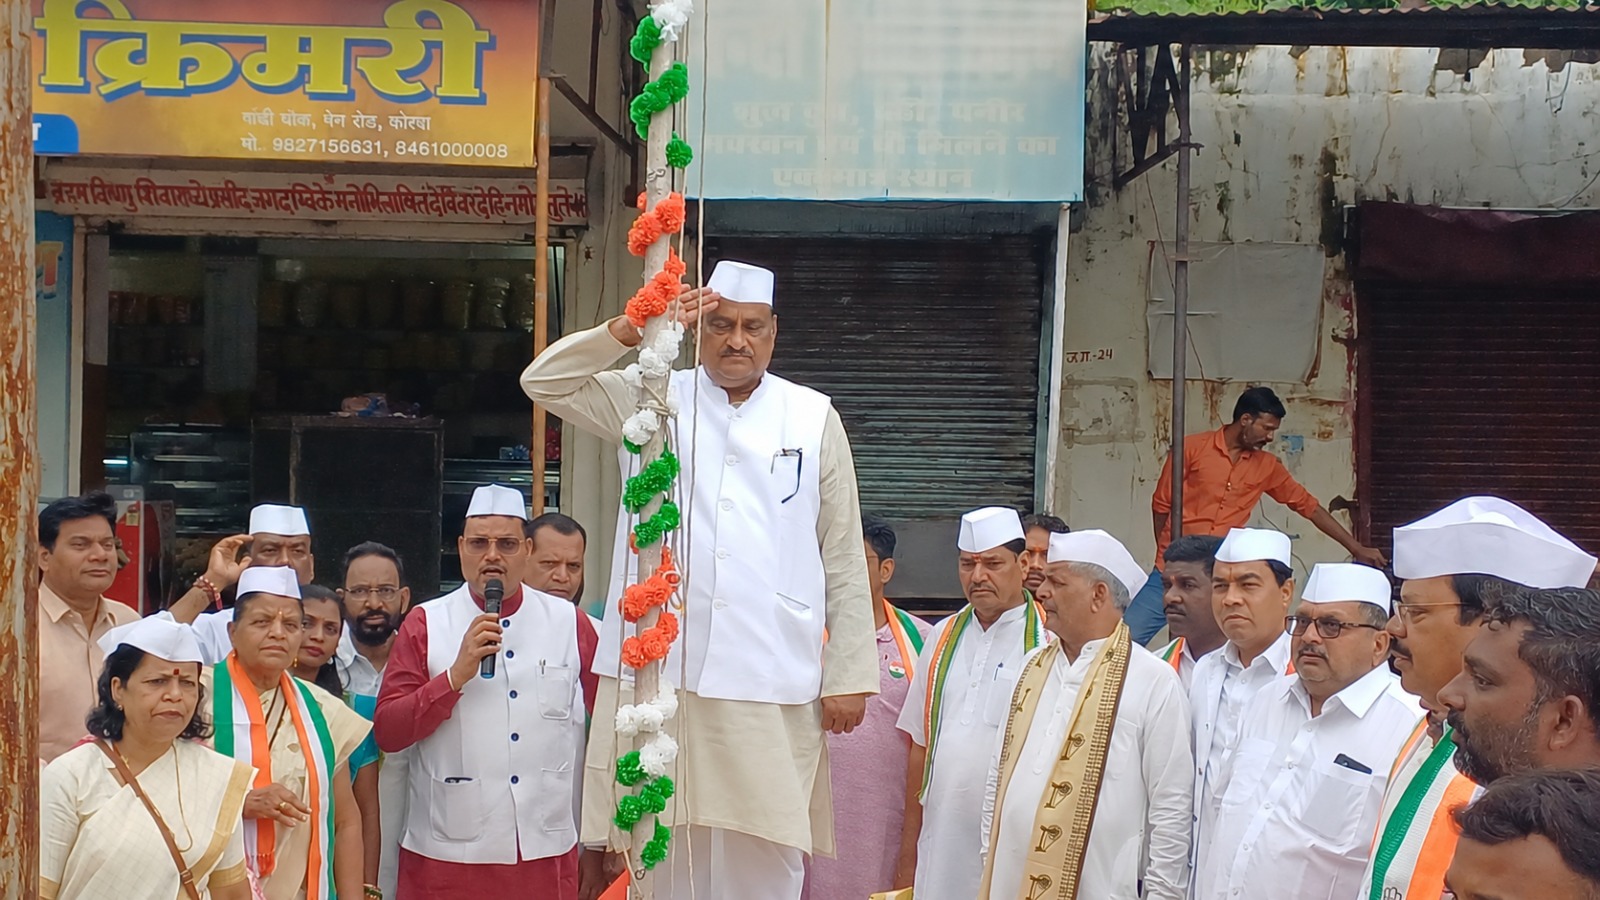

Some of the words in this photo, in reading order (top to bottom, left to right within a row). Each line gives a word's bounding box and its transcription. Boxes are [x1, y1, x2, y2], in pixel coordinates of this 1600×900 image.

[34, 0, 494, 103] क्रिमरी
[351, 110, 384, 131] रोड,
[272, 137, 389, 158] 9827156631,
[395, 141, 509, 159] 8461000008
[1016, 136, 1061, 156] का
